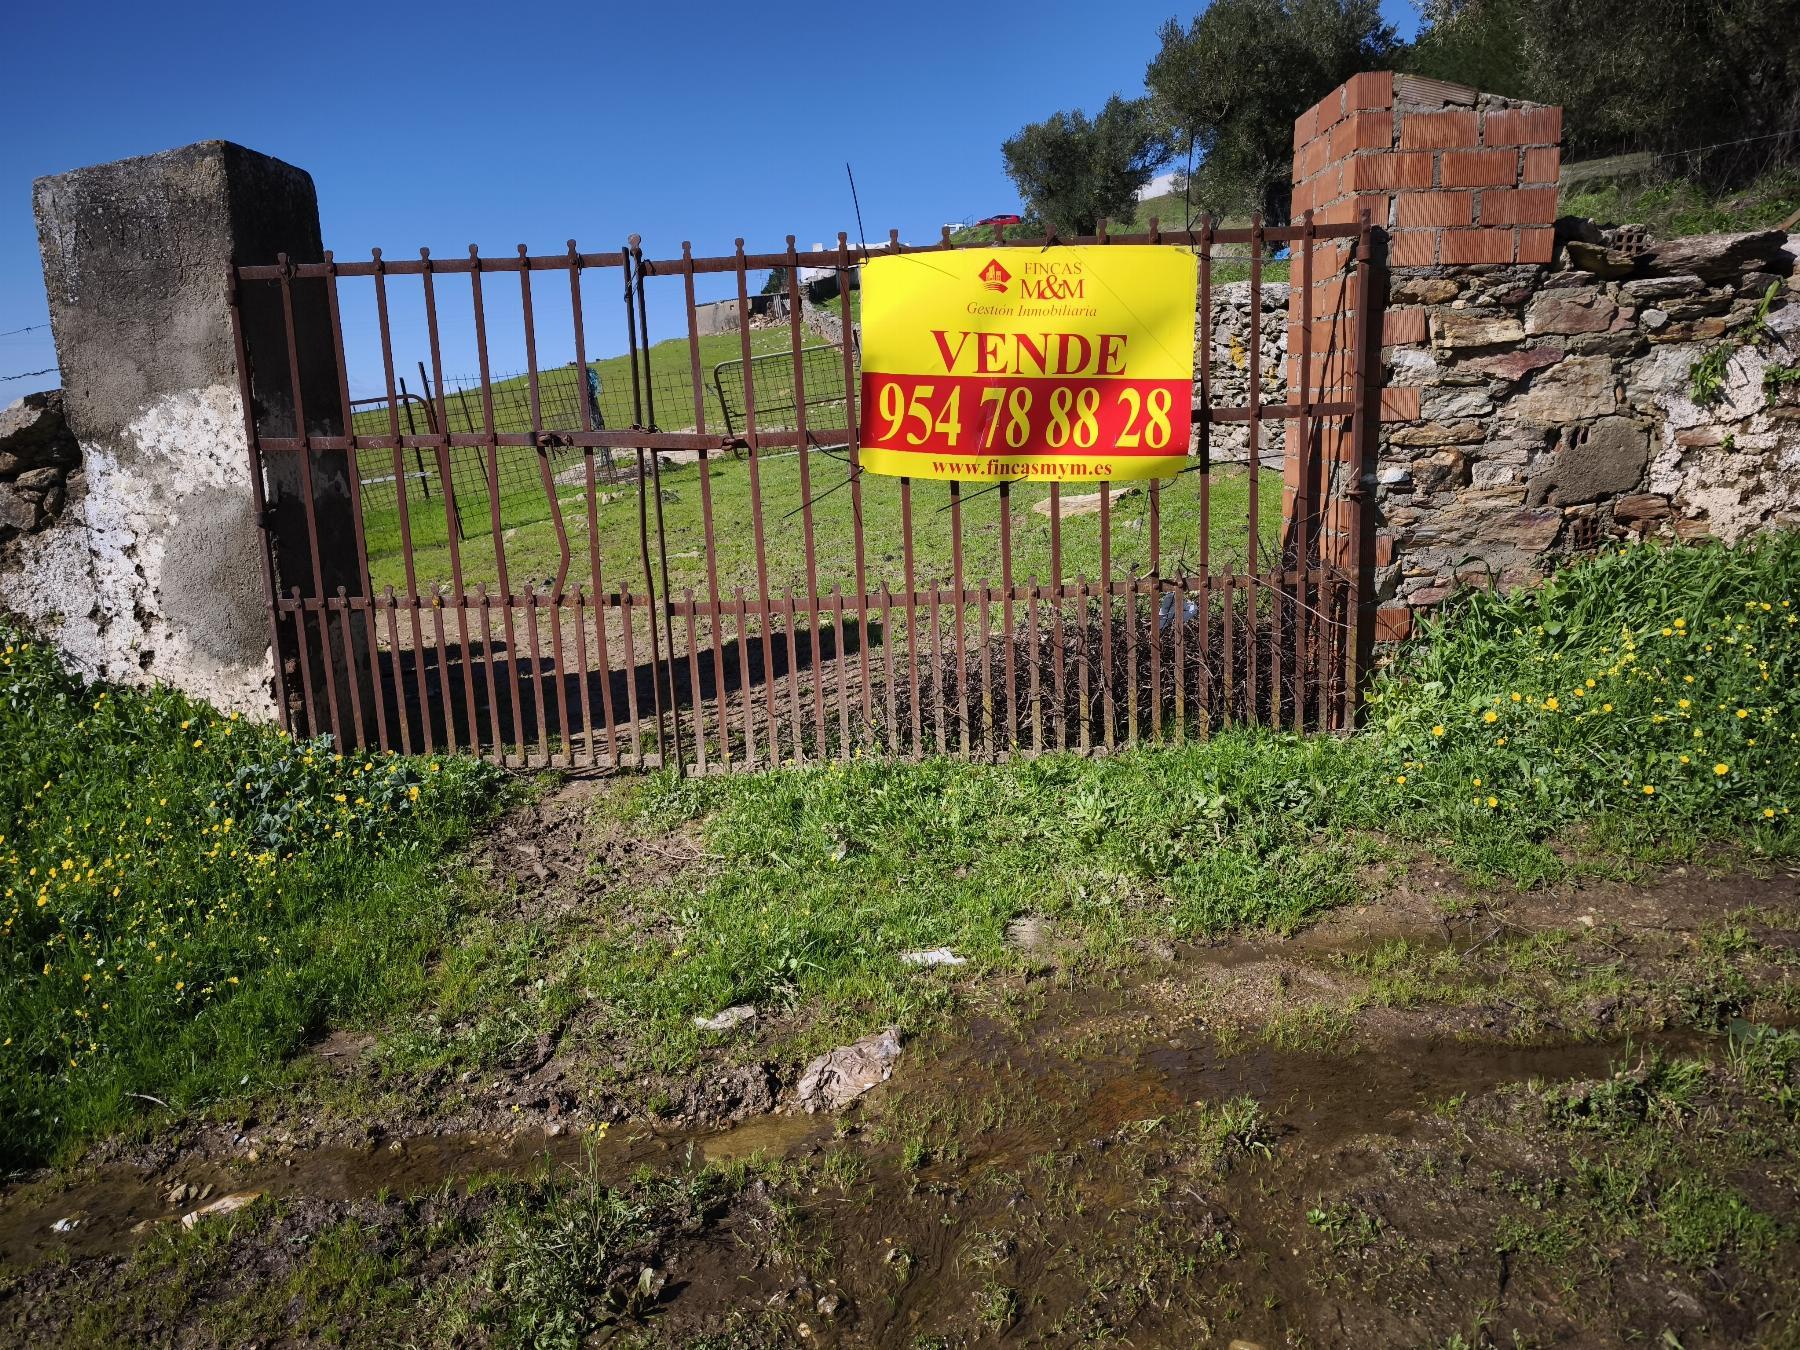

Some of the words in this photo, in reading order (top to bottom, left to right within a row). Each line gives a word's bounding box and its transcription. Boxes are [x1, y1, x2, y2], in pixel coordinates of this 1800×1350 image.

[1024, 262, 1082, 275] FINCAS
[1020, 275, 1085, 300] M&M
[966, 301, 1014, 317] Gestión
[1017, 304, 1098, 318] Inmobiliaria
[930, 330, 1128, 376] VENDE
[877, 382, 962, 446] 954
[979, 386, 1033, 448] 78
[1045, 386, 1100, 448] 88
[1114, 387, 1172, 449] 28
[932, 459, 1112, 479] www.fincasmym.es
